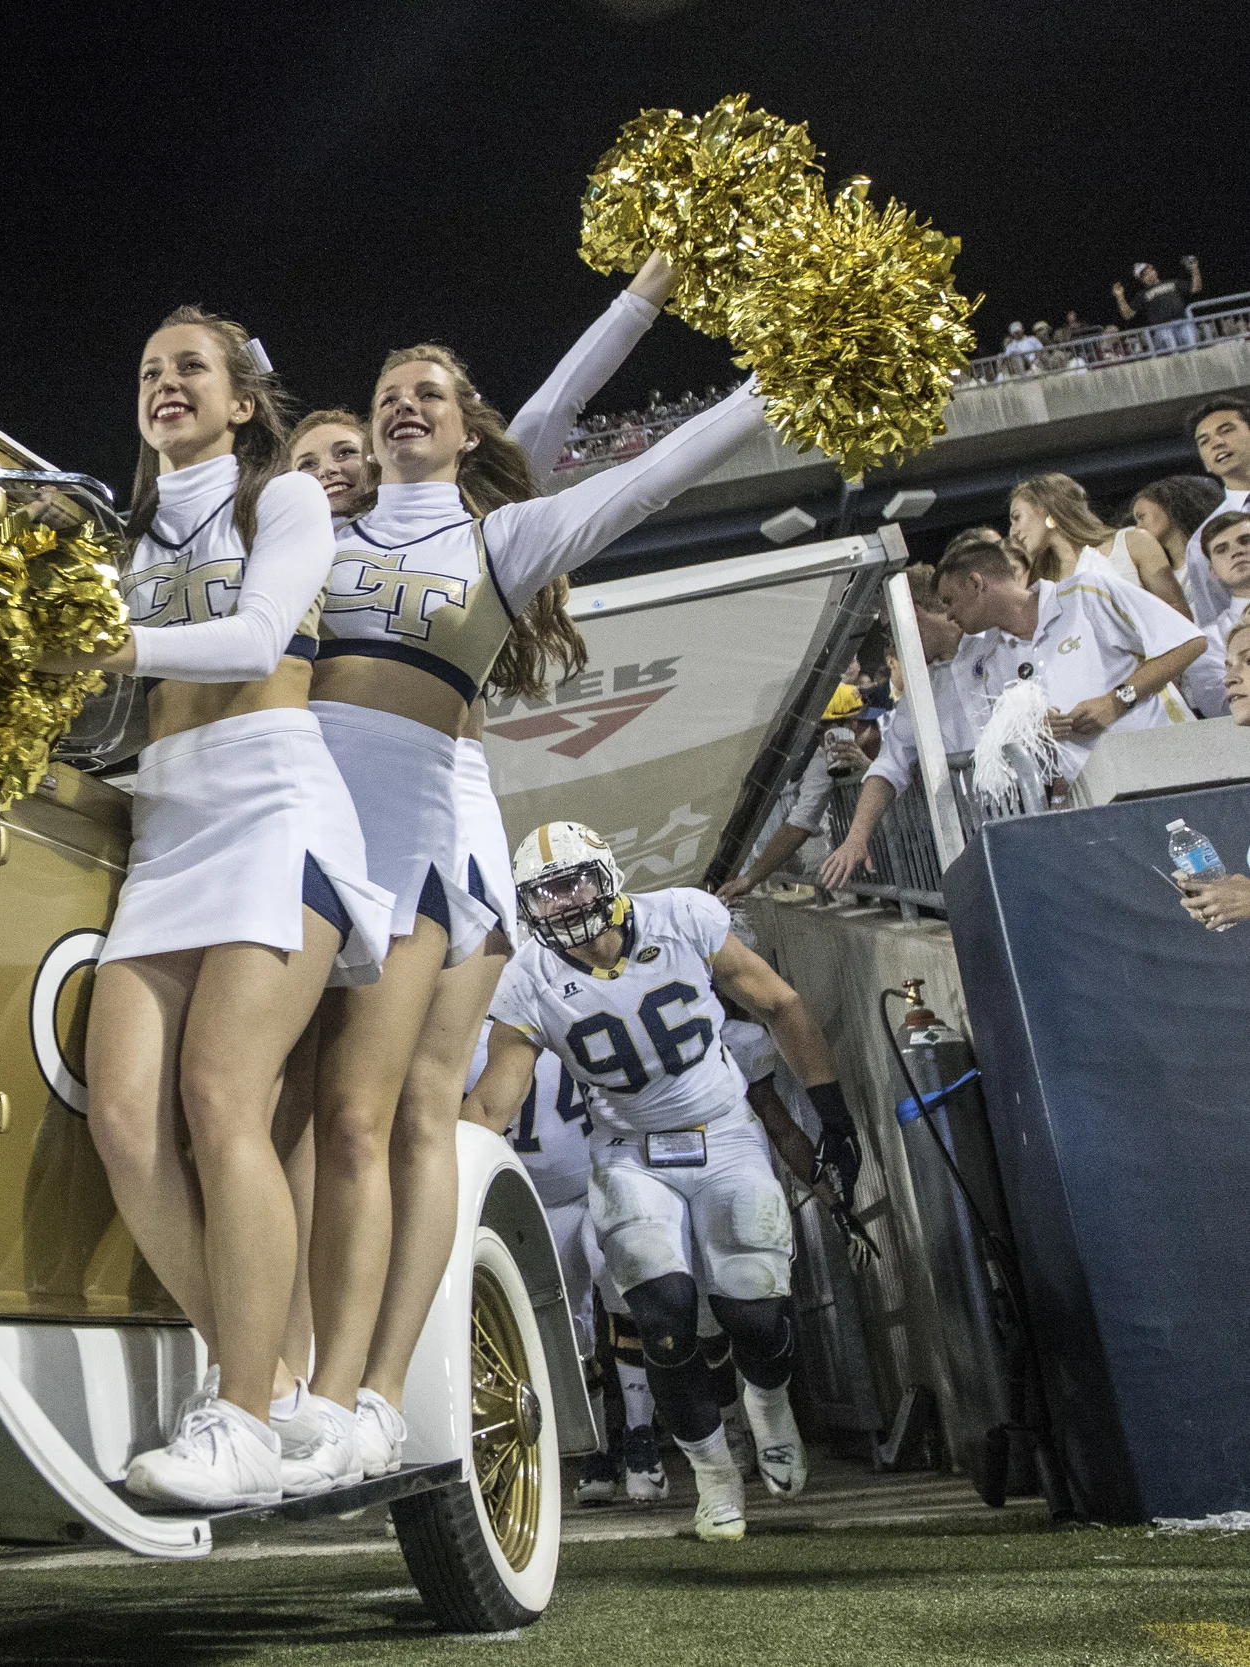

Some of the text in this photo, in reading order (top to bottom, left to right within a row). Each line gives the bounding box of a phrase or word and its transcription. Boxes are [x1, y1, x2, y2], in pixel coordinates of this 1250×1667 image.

[121, 550, 246, 629] GT
[323, 550, 468, 641] GT
[565, 977, 715, 1095] 96
